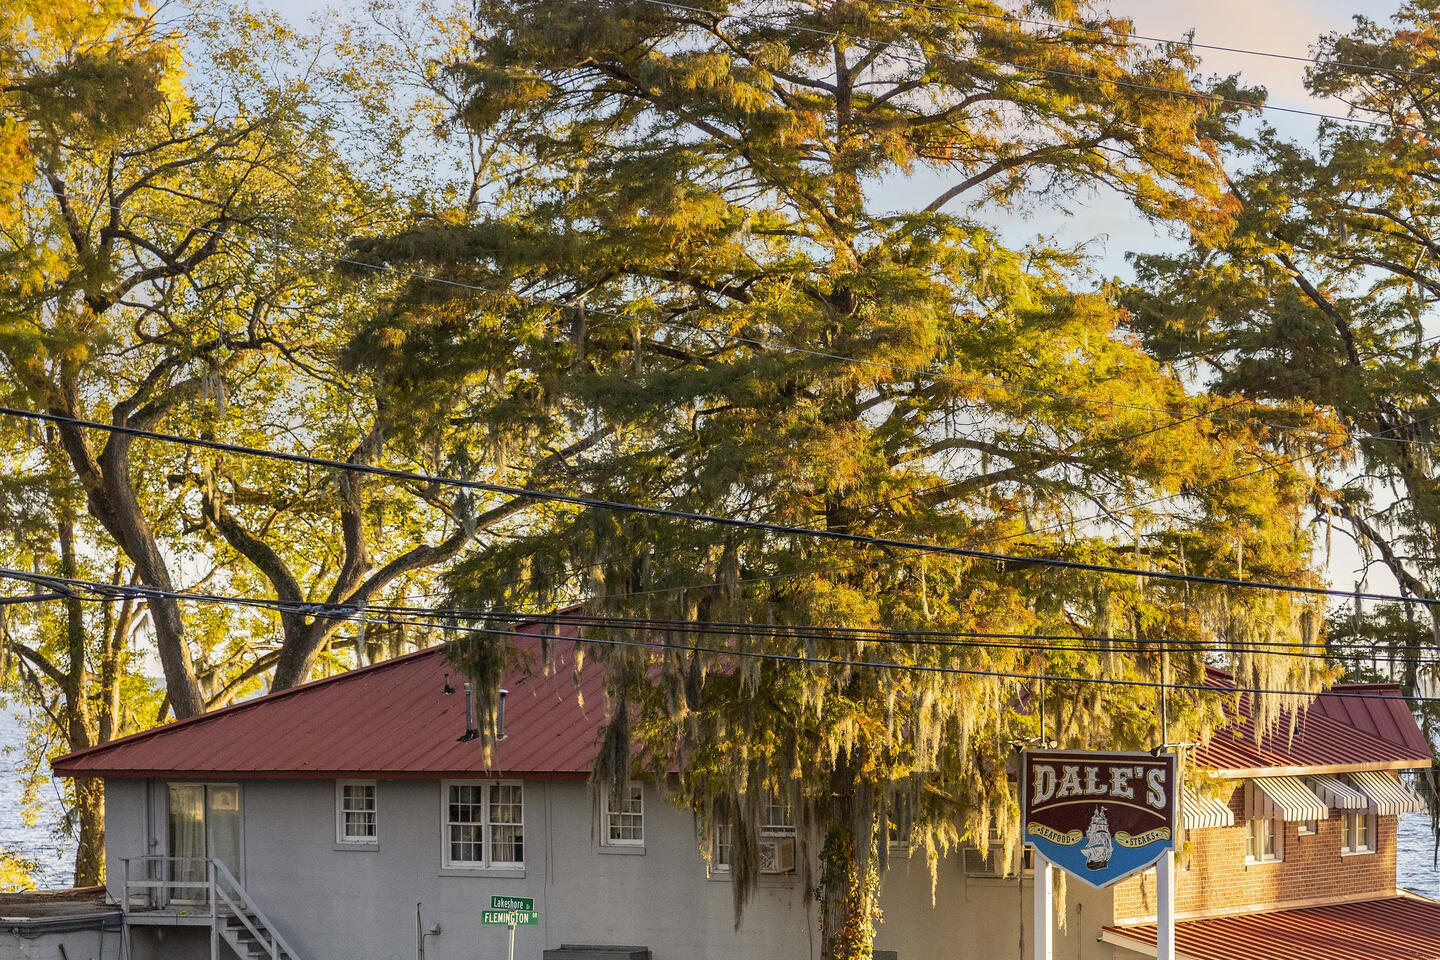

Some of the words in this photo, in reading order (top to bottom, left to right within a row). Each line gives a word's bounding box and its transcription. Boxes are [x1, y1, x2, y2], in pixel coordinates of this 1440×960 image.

[1032, 764, 1167, 810] DALE'S
[1040, 827, 1071, 844] SEAFOOD
[1129, 832, 1157, 847] STEAKS
[493, 897, 524, 909] Lakeshore
[484, 912, 529, 923] FLEMINGTON
